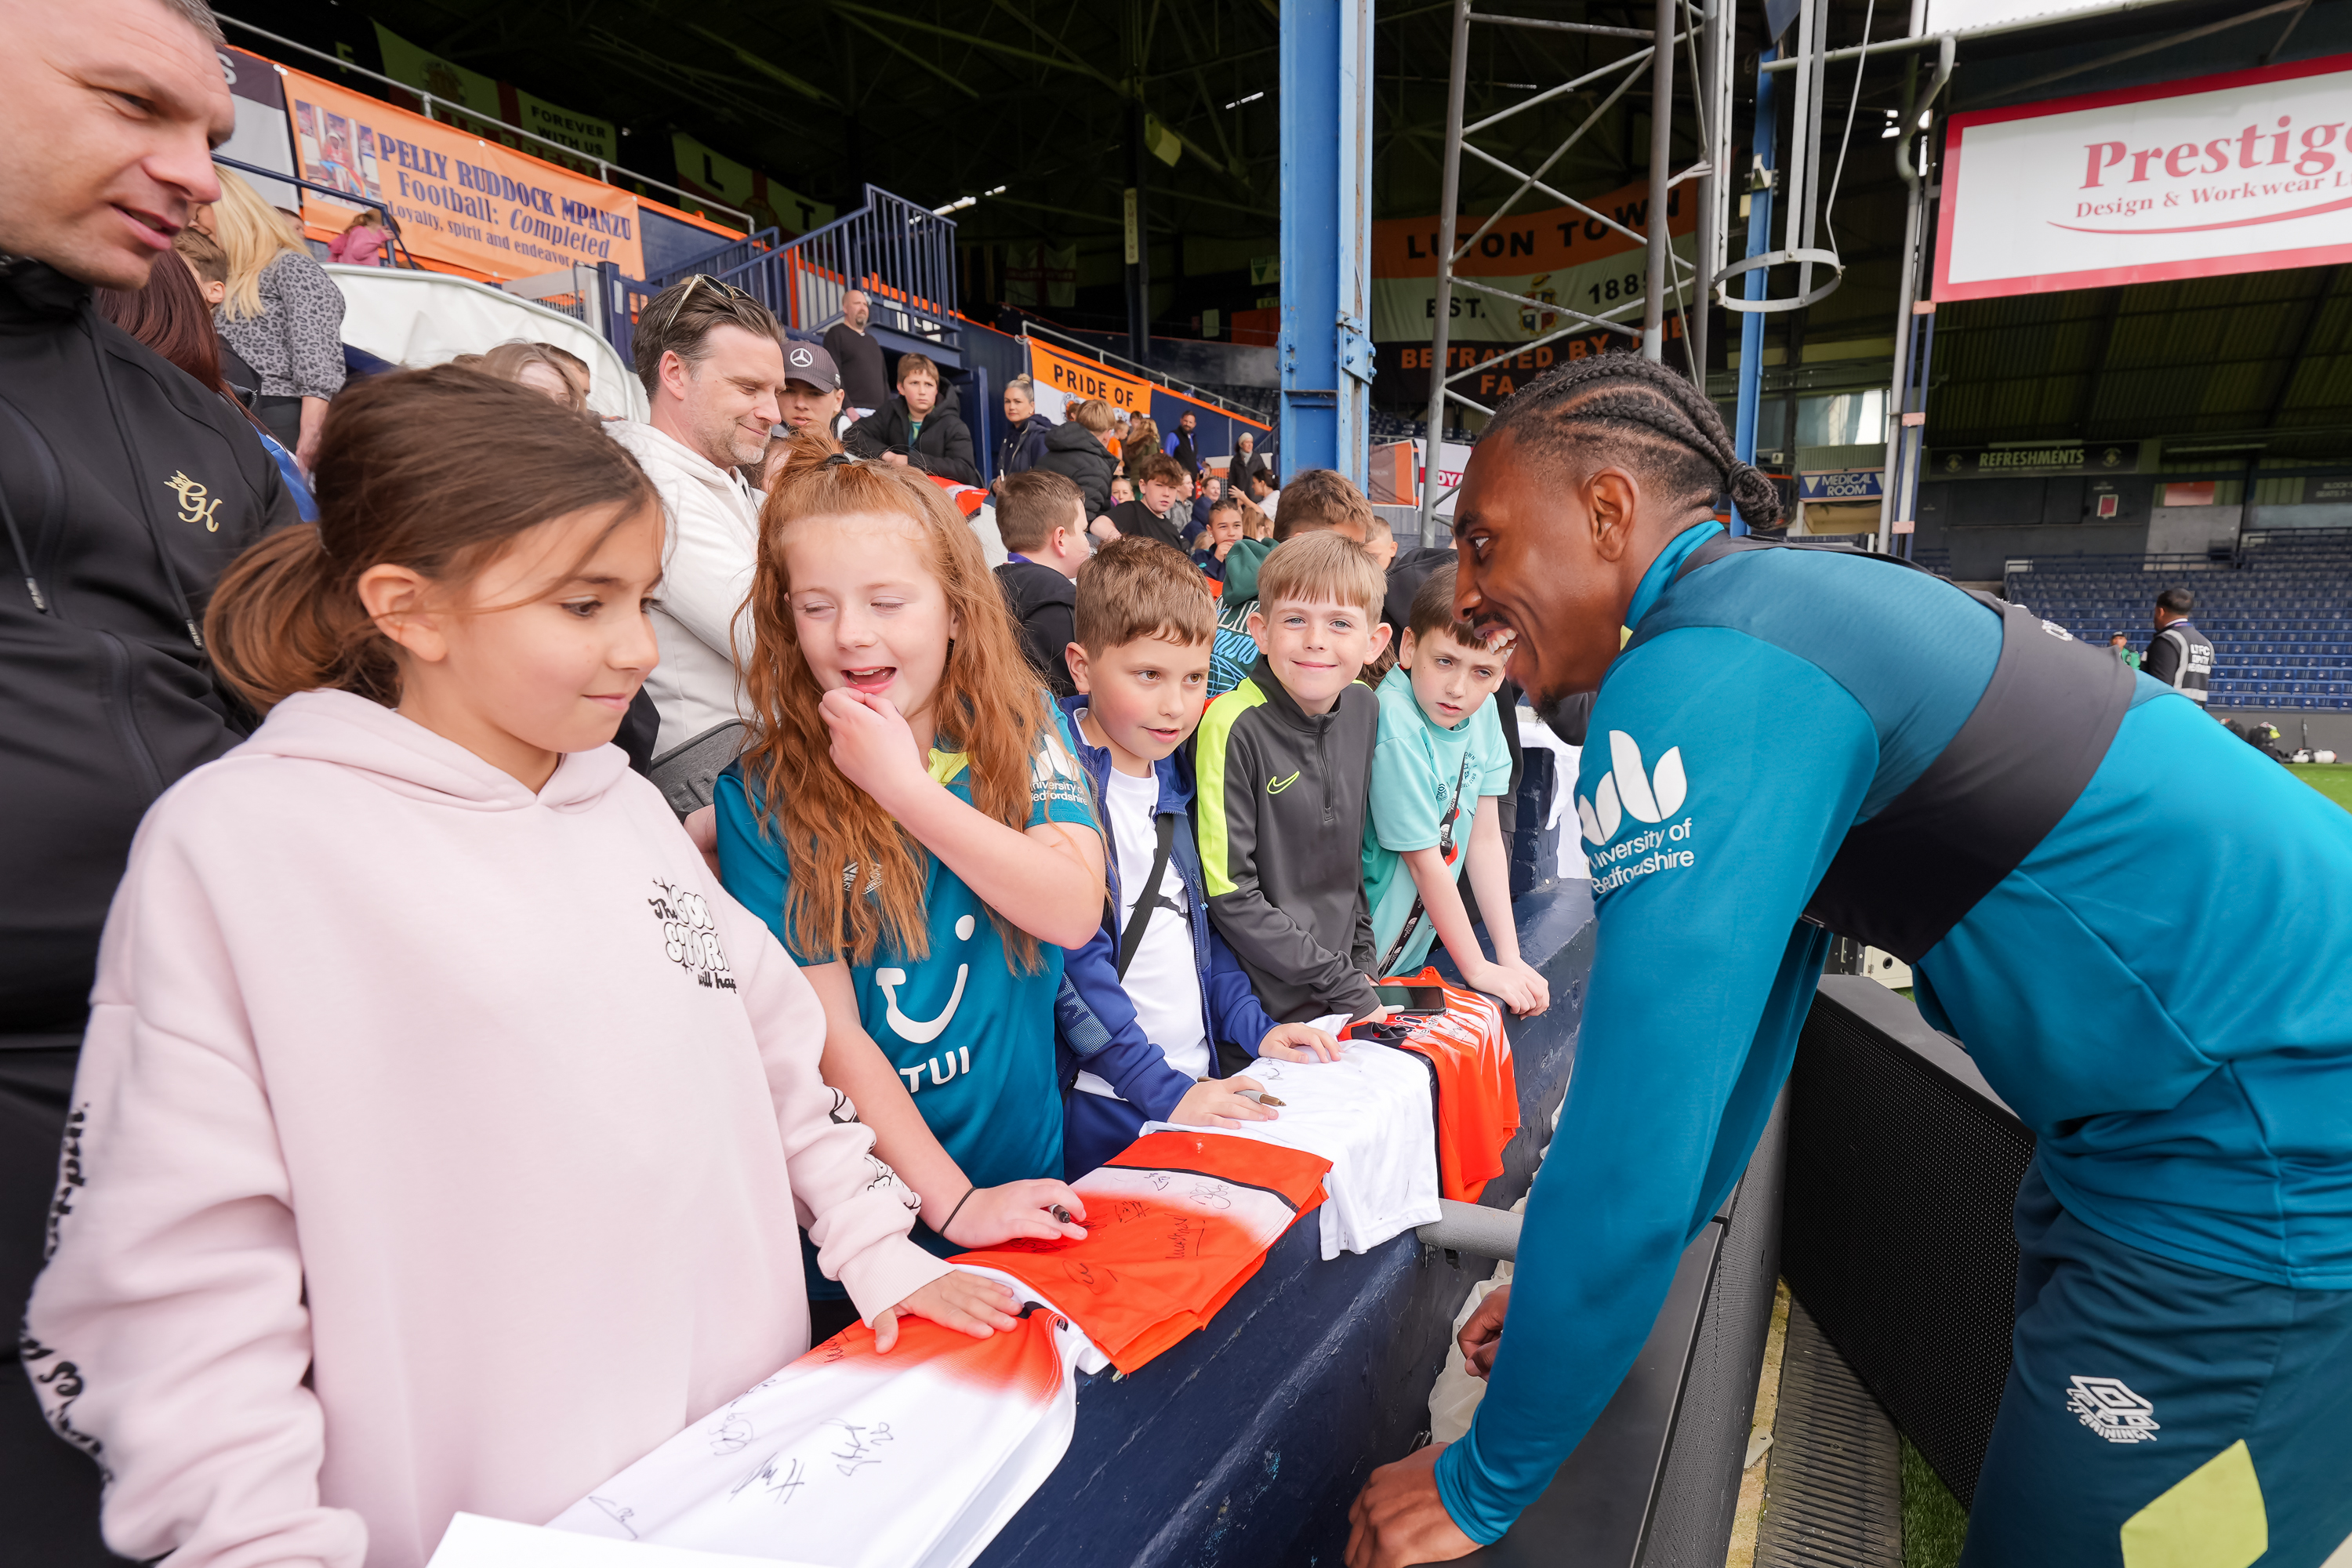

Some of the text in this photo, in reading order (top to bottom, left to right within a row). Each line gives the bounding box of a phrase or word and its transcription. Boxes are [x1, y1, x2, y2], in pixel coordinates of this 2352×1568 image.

[531, 105, 606, 139] FOREVER
[537, 125, 604, 156] WITH US
[2079, 114, 2352, 190] Prestig
[377, 132, 632, 240] PELLY RUDDOCK MPANZU
[2076, 198, 2154, 218] Design
[2163, 191, 2181, 208] &
[2334, 171, 2352, 188] L
[388, 201, 570, 267] Loyalty, spirit and endeavor
[397, 170, 610, 260] Football: Completed
[1426, 270, 1646, 318] EST. 188
[1401, 346, 1554, 369] BETRAYED
[1569, 333, 1610, 361] BY
[1054, 363, 1106, 400] PRIDE
[1114, 387, 1134, 407] OF
[1978, 448, 2085, 467] REFRESHMENTS
[1821, 473, 1872, 486] MEDICAL
[1827, 485, 1867, 497] ROOM
[1030, 780, 1076, 792] niversity
[1669, 817, 1693, 841] of
[899, 1046, 970, 1093] TUI
